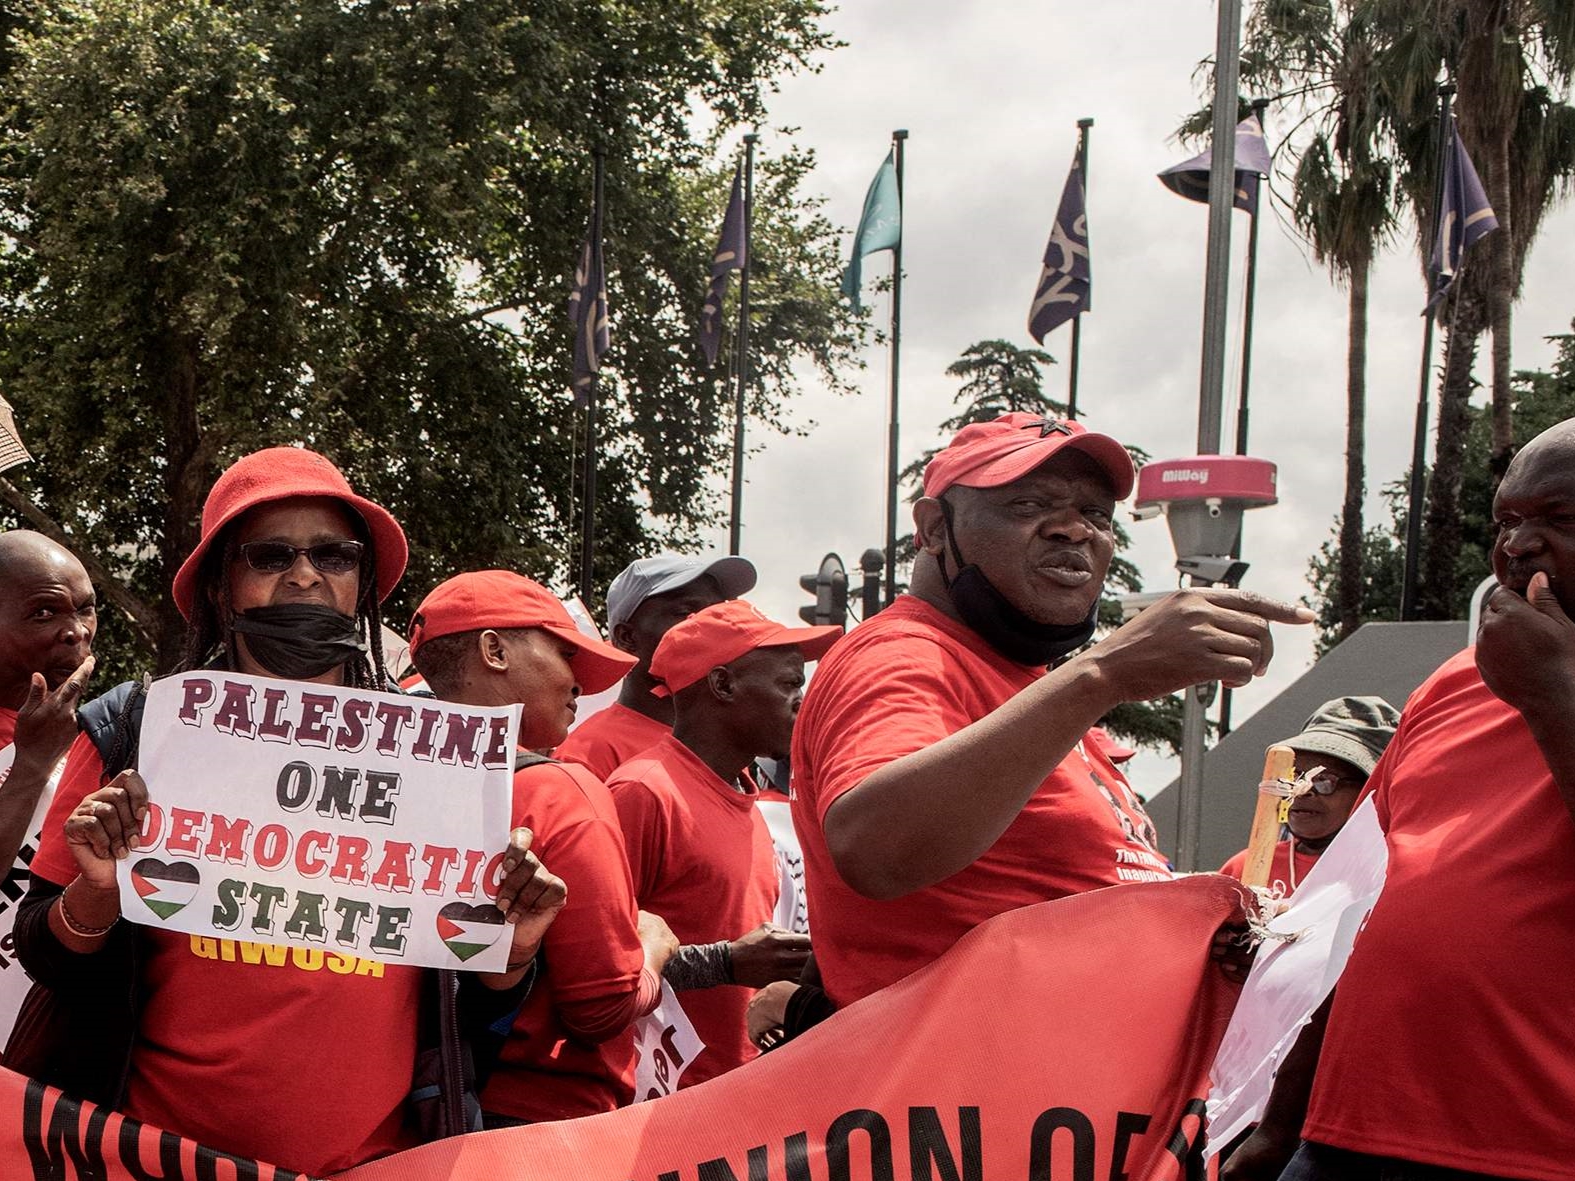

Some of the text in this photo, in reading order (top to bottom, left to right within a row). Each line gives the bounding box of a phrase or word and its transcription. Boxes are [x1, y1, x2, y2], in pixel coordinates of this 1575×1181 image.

[180, 679, 509, 771] PALESTINE
[276, 760, 402, 826] ONE
[129, 802, 508, 901] DEMOCRATIC
[212, 878, 413, 957] STATE
